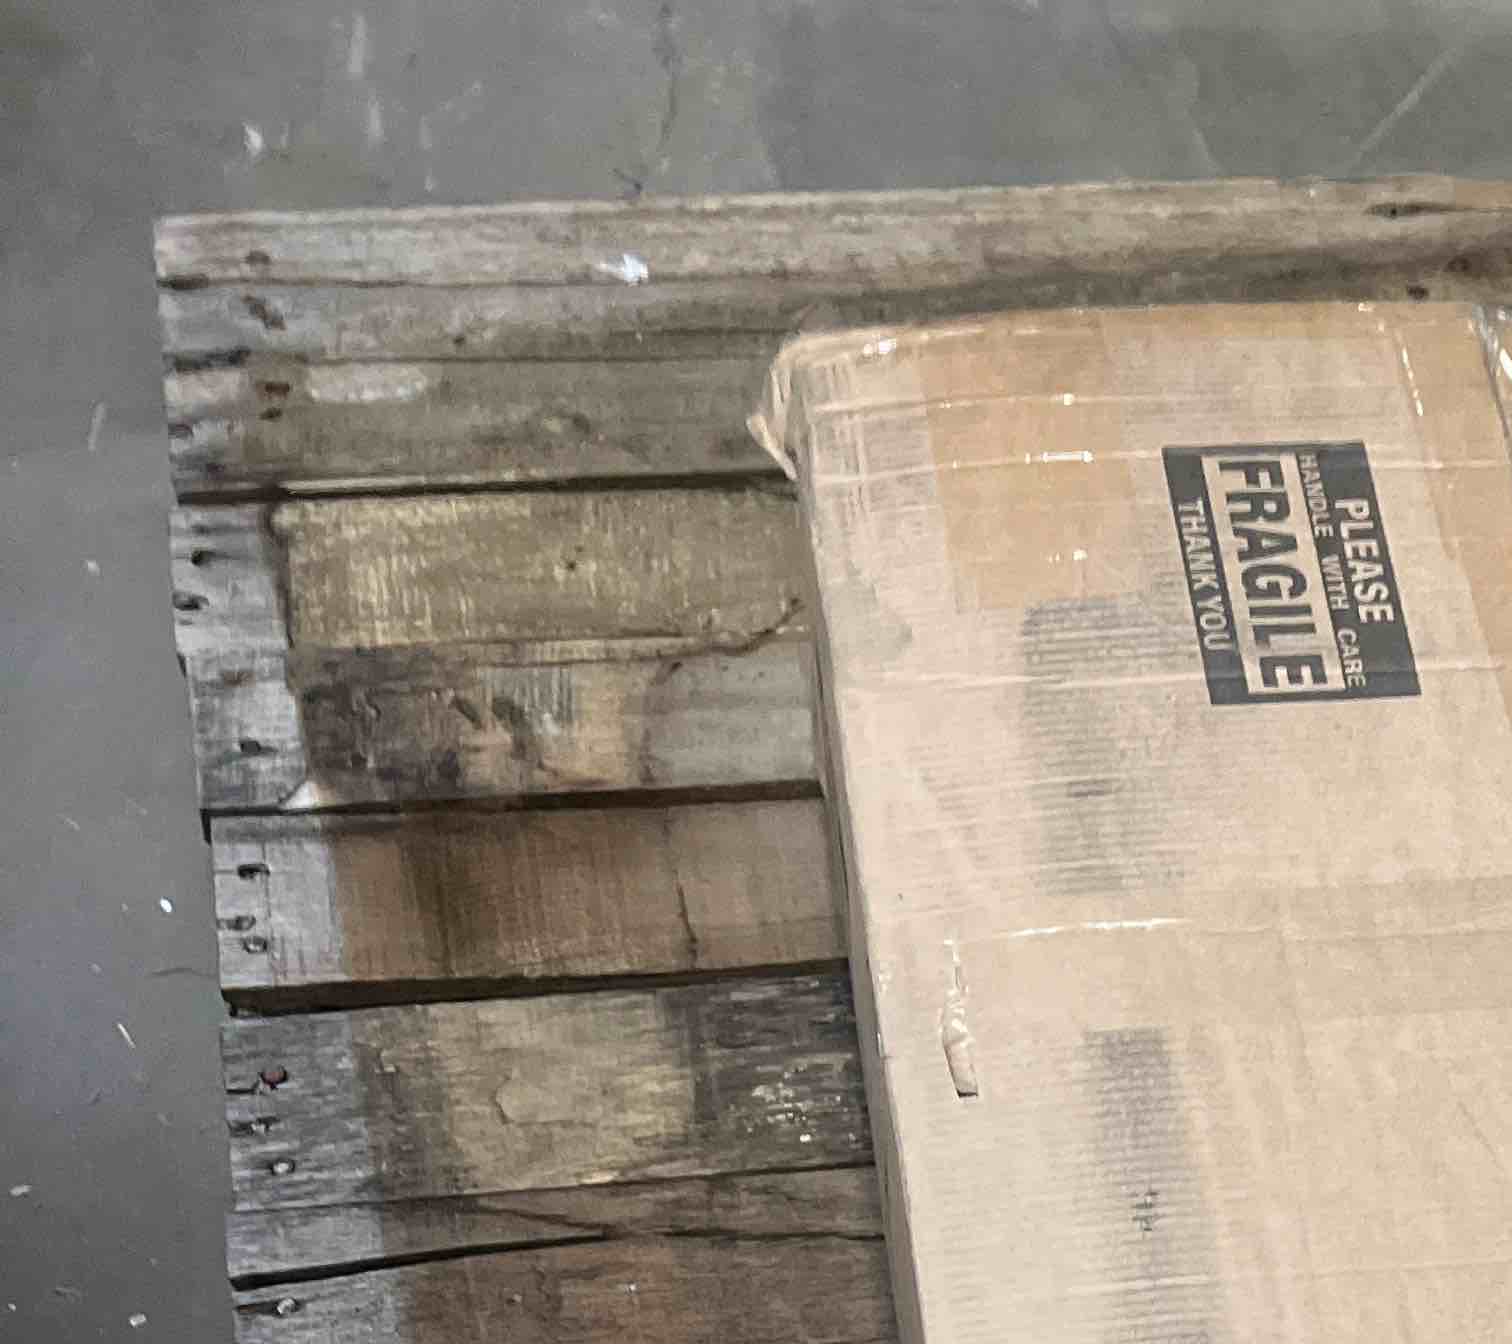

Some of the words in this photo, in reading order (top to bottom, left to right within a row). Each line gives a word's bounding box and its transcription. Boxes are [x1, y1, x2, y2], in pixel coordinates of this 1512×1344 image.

[1178, 496, 1219, 593] THANK
[1217, 460, 1329, 688] FRAGILE
[1300, 452, 1334, 538] HANDLE
[1321, 553, 1350, 611] WITH
[1336, 627, 1367, 688] CARE
[1334, 498, 1395, 623] PLEASE
[1196, 594, 1233, 652] YOU
